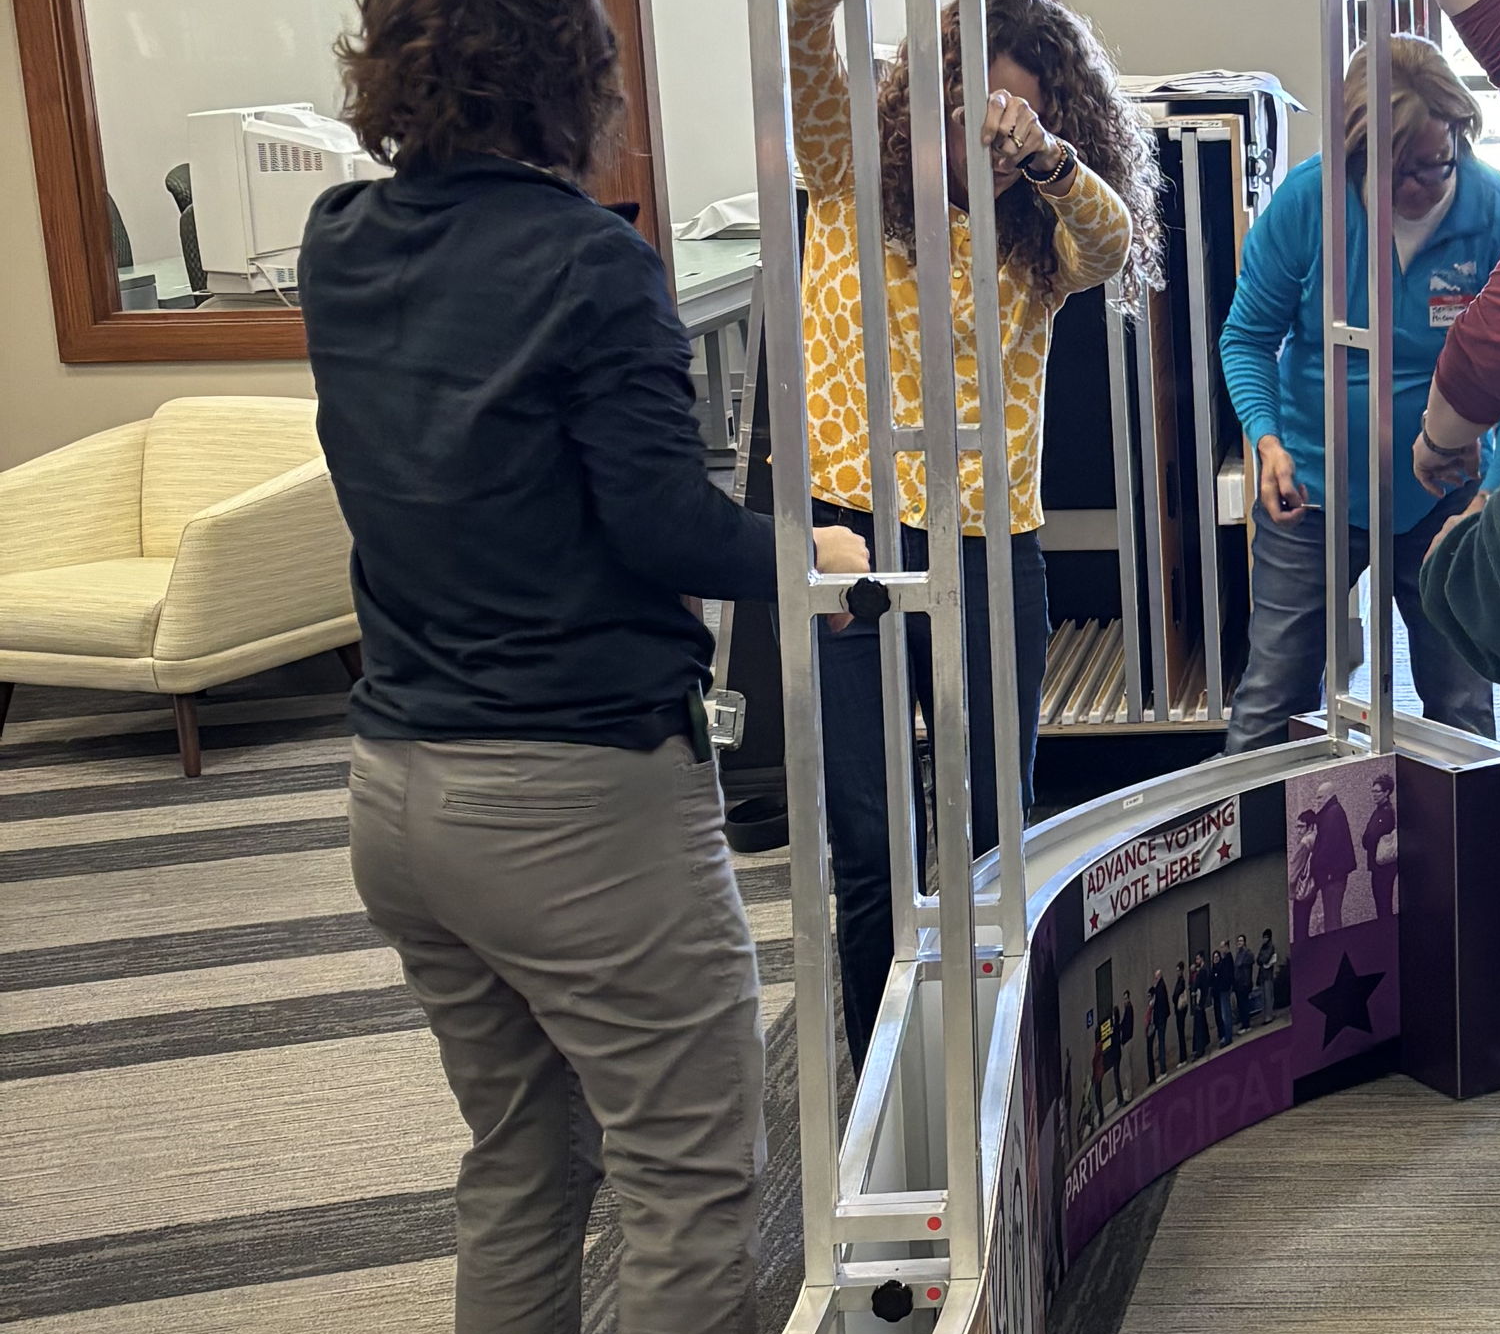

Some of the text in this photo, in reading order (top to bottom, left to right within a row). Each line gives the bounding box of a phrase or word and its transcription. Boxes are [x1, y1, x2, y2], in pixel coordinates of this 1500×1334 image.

[1086, 801, 1236, 900] ADVANCE VOTING
[1109, 850, 1201, 918] VOTE HERE
[1064, 1100, 1152, 1211] PARTICIPATE
